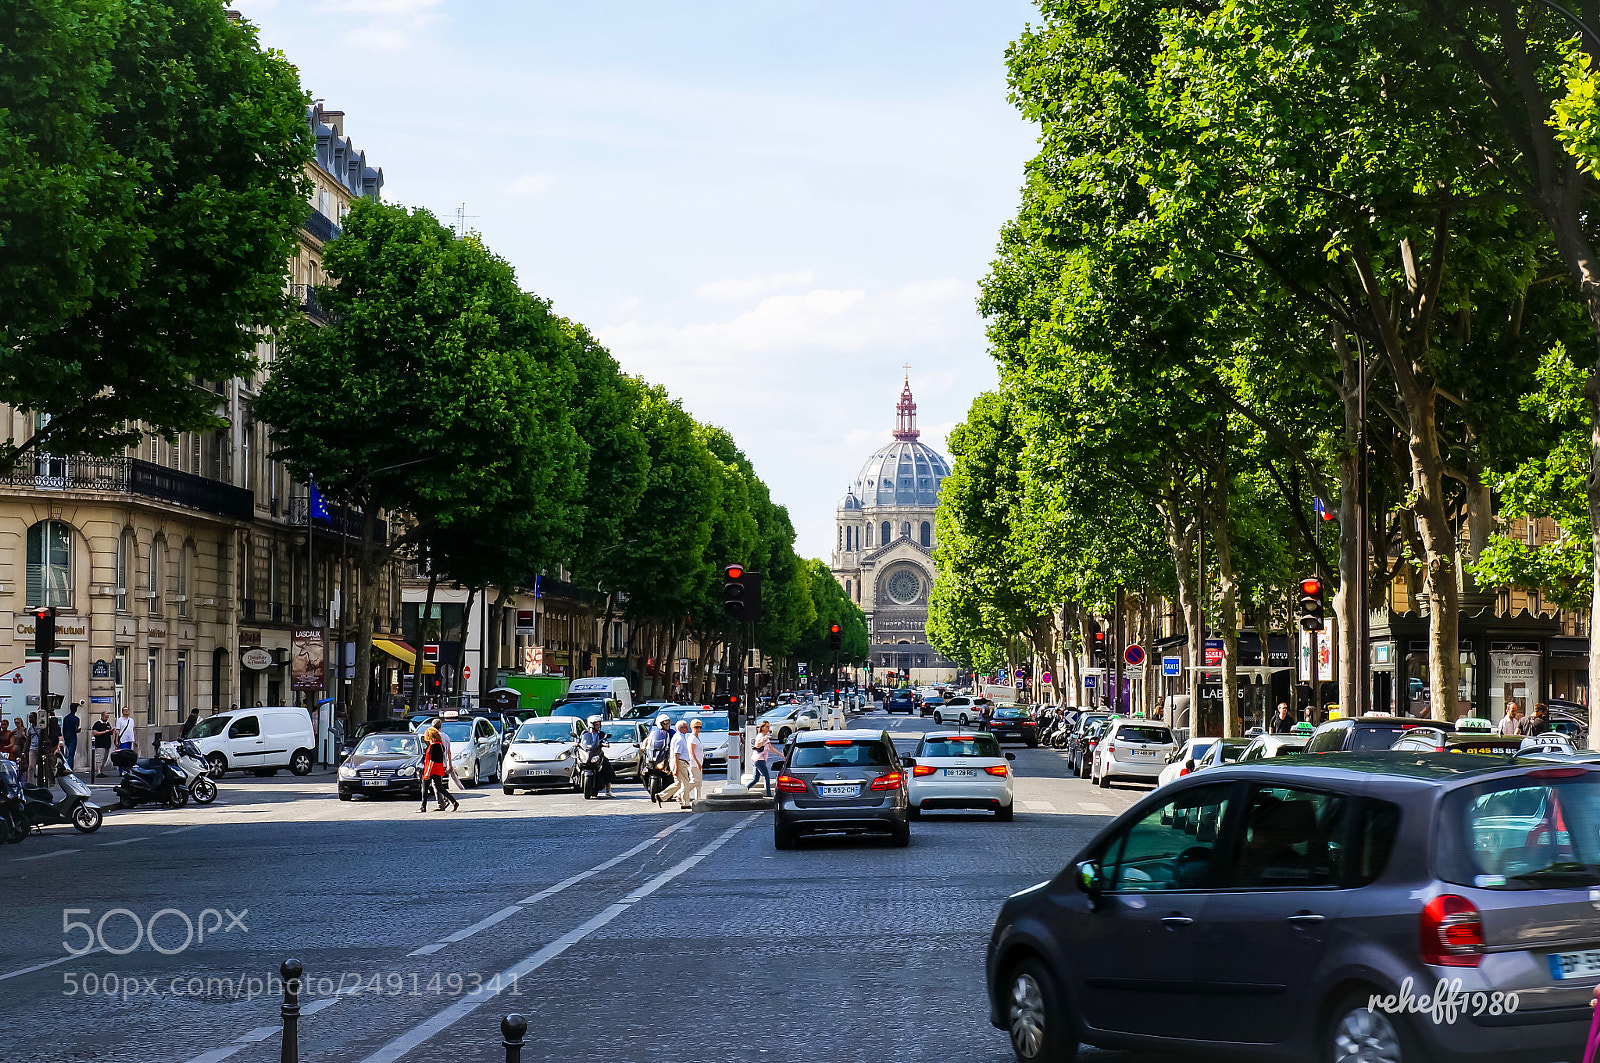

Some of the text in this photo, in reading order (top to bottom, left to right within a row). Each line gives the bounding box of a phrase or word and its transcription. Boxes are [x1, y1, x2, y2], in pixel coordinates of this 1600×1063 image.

[295, 630, 321, 638] LASCAUX
[1498, 658, 1532, 667] The Mortal
[1496, 667, 1534, 675] Instruments
[1464, 720, 1486, 728] TAXI
